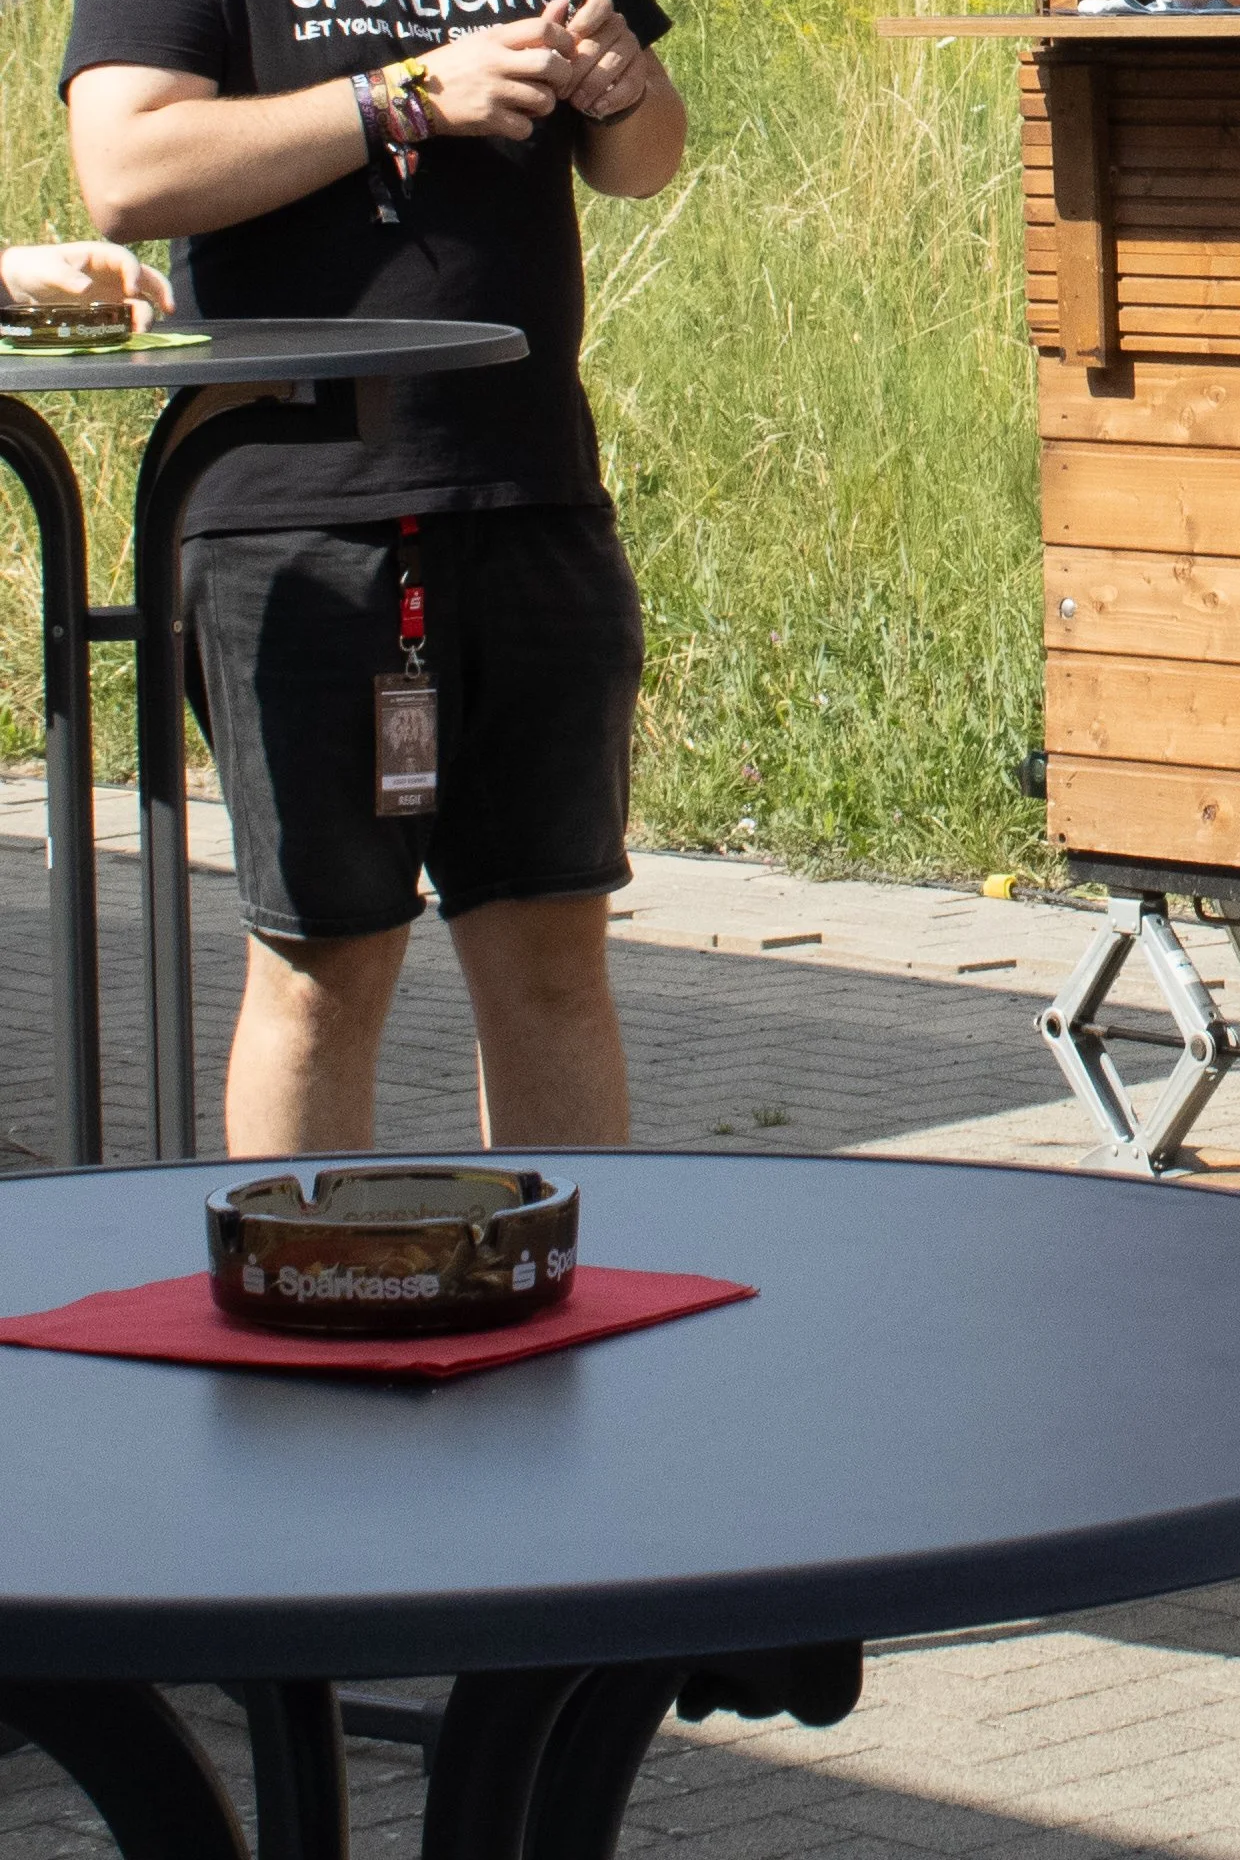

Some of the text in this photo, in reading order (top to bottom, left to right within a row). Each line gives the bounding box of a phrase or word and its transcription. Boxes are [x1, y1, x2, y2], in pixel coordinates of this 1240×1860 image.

[294, 18, 332, 41] LET
[396, 21, 442, 44] LIGHT
[277, 1265, 440, 1303] Sparkasse
